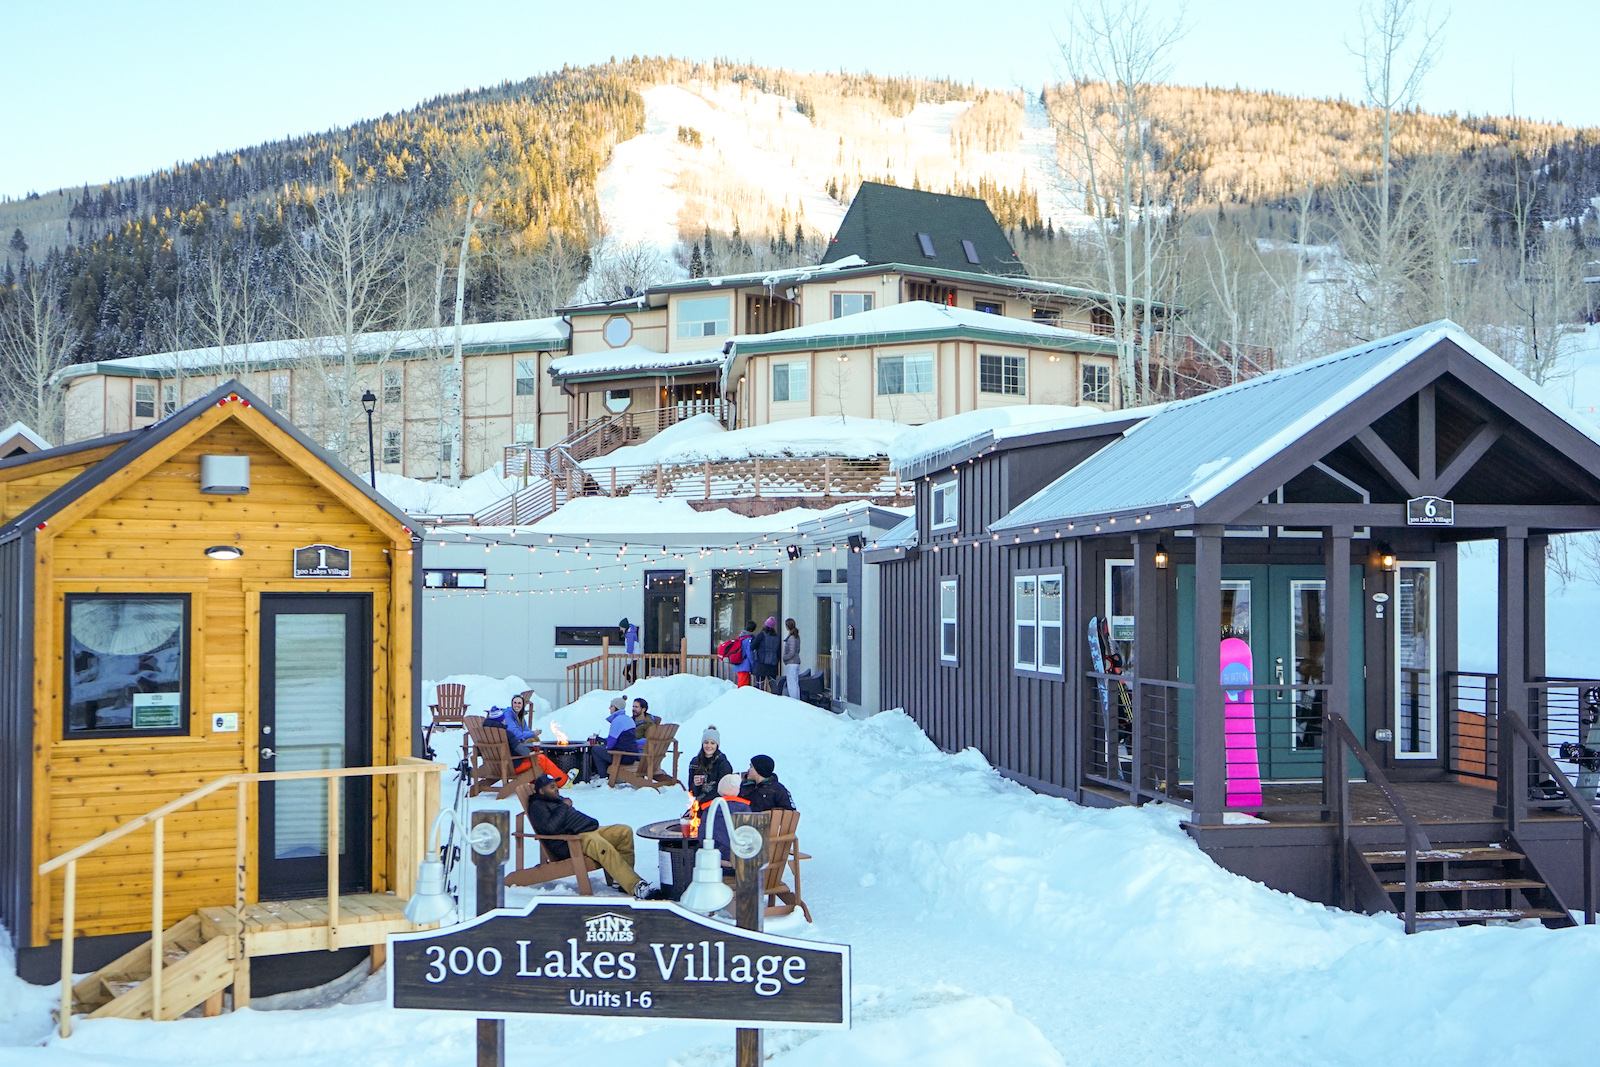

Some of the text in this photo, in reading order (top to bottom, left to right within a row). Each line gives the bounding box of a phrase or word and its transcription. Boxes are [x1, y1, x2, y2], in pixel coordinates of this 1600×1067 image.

[1425, 500, 1436, 517] 6
[317, 548, 329, 569] 1
[296, 567, 350, 577] 300 Lakes Village
[1223, 671, 1249, 685] BURTON
[585, 915, 634, 932] TINY
[585, 931, 635, 942] HOMES
[425, 937, 807, 997] 300 Lakes Village
[569, 989, 652, 1009] Units 1-6
